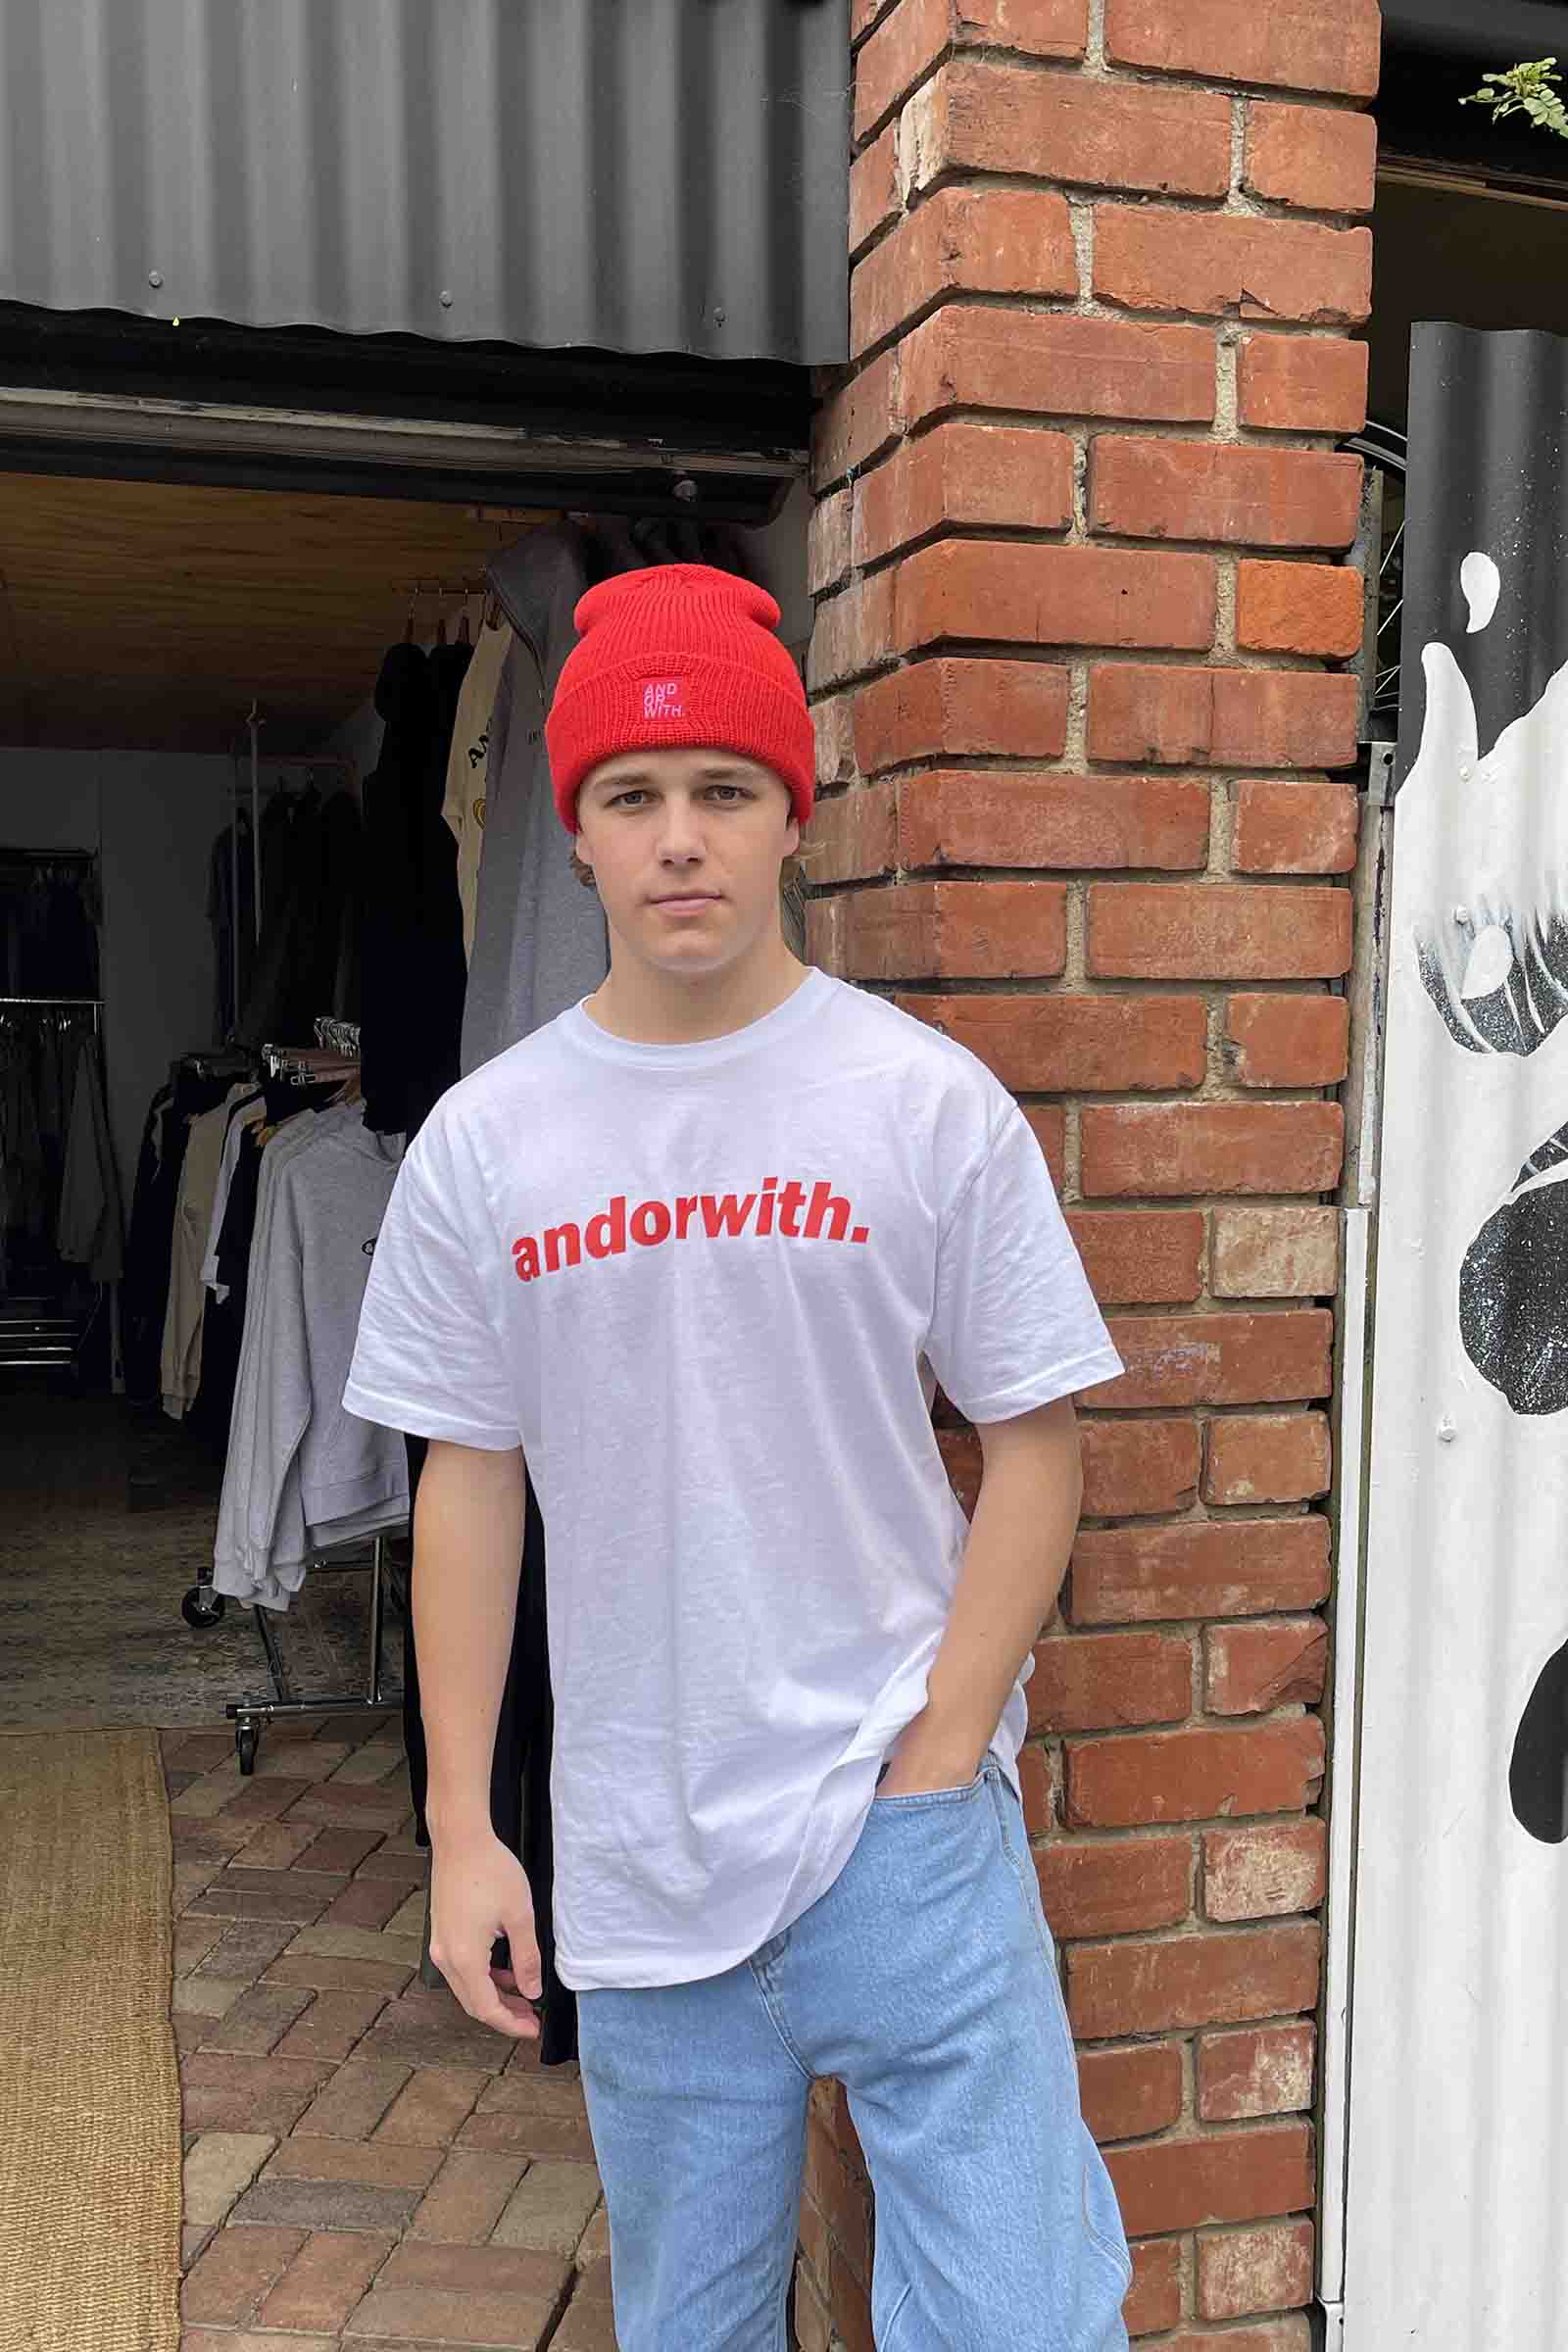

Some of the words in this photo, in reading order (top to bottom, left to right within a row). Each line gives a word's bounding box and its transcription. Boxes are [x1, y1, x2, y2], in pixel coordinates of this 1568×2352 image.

[644, 683, 677, 696] AND
[644, 695, 666, 707] OR
[512, 1177, 869, 1283] andorwith.
